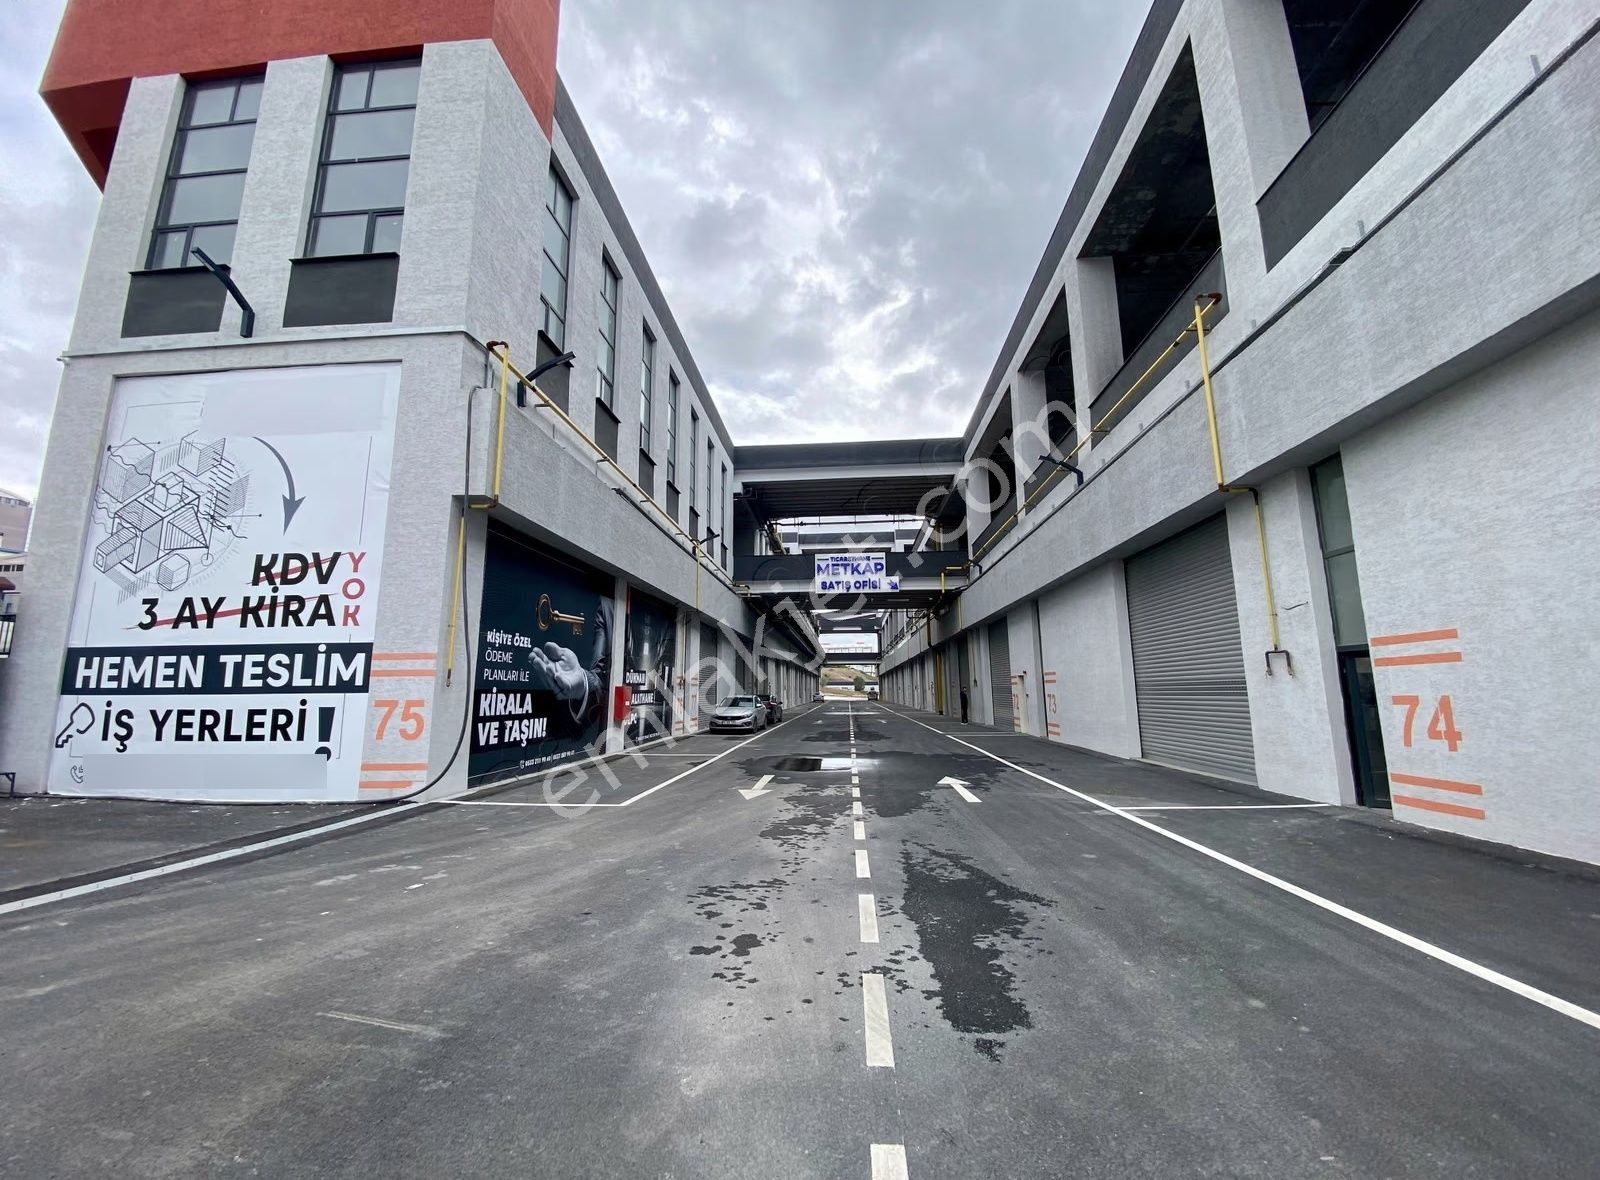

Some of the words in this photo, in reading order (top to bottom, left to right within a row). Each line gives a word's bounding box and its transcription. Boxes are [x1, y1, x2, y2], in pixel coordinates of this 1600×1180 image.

[251, 551, 342, 587] KDV
[816, 562, 885, 576] METKAP
[341, 551, 367, 627] YOK
[821, 580, 851, 592] SATIŞ
[137, 597, 160, 631] 3
[171, 596, 227, 630] AY
[239, 585, 337, 629] KİRA
[486, 628, 512, 648] KİŞİYE
[513, 632, 532, 648] ÖZEL
[74, 654, 206, 690] HEMEN
[219, 643, 367, 688] TESLİM
[485, 646, 513, 664] ÖDEME
[483, 668, 519, 682] PLANLARI
[519, 667, 530, 682] İLE
[479, 686, 533, 717] KİRALA
[1046, 693, 1057, 714] 73
[101, 699, 135, 753] İŞ
[149, 698, 308, 743] YERLERİ
[373, 699, 426, 742] 75
[477, 721, 500, 747] VE
[503, 717, 548, 748] TAŞIN!
[1391, 694, 1463, 753] 74
